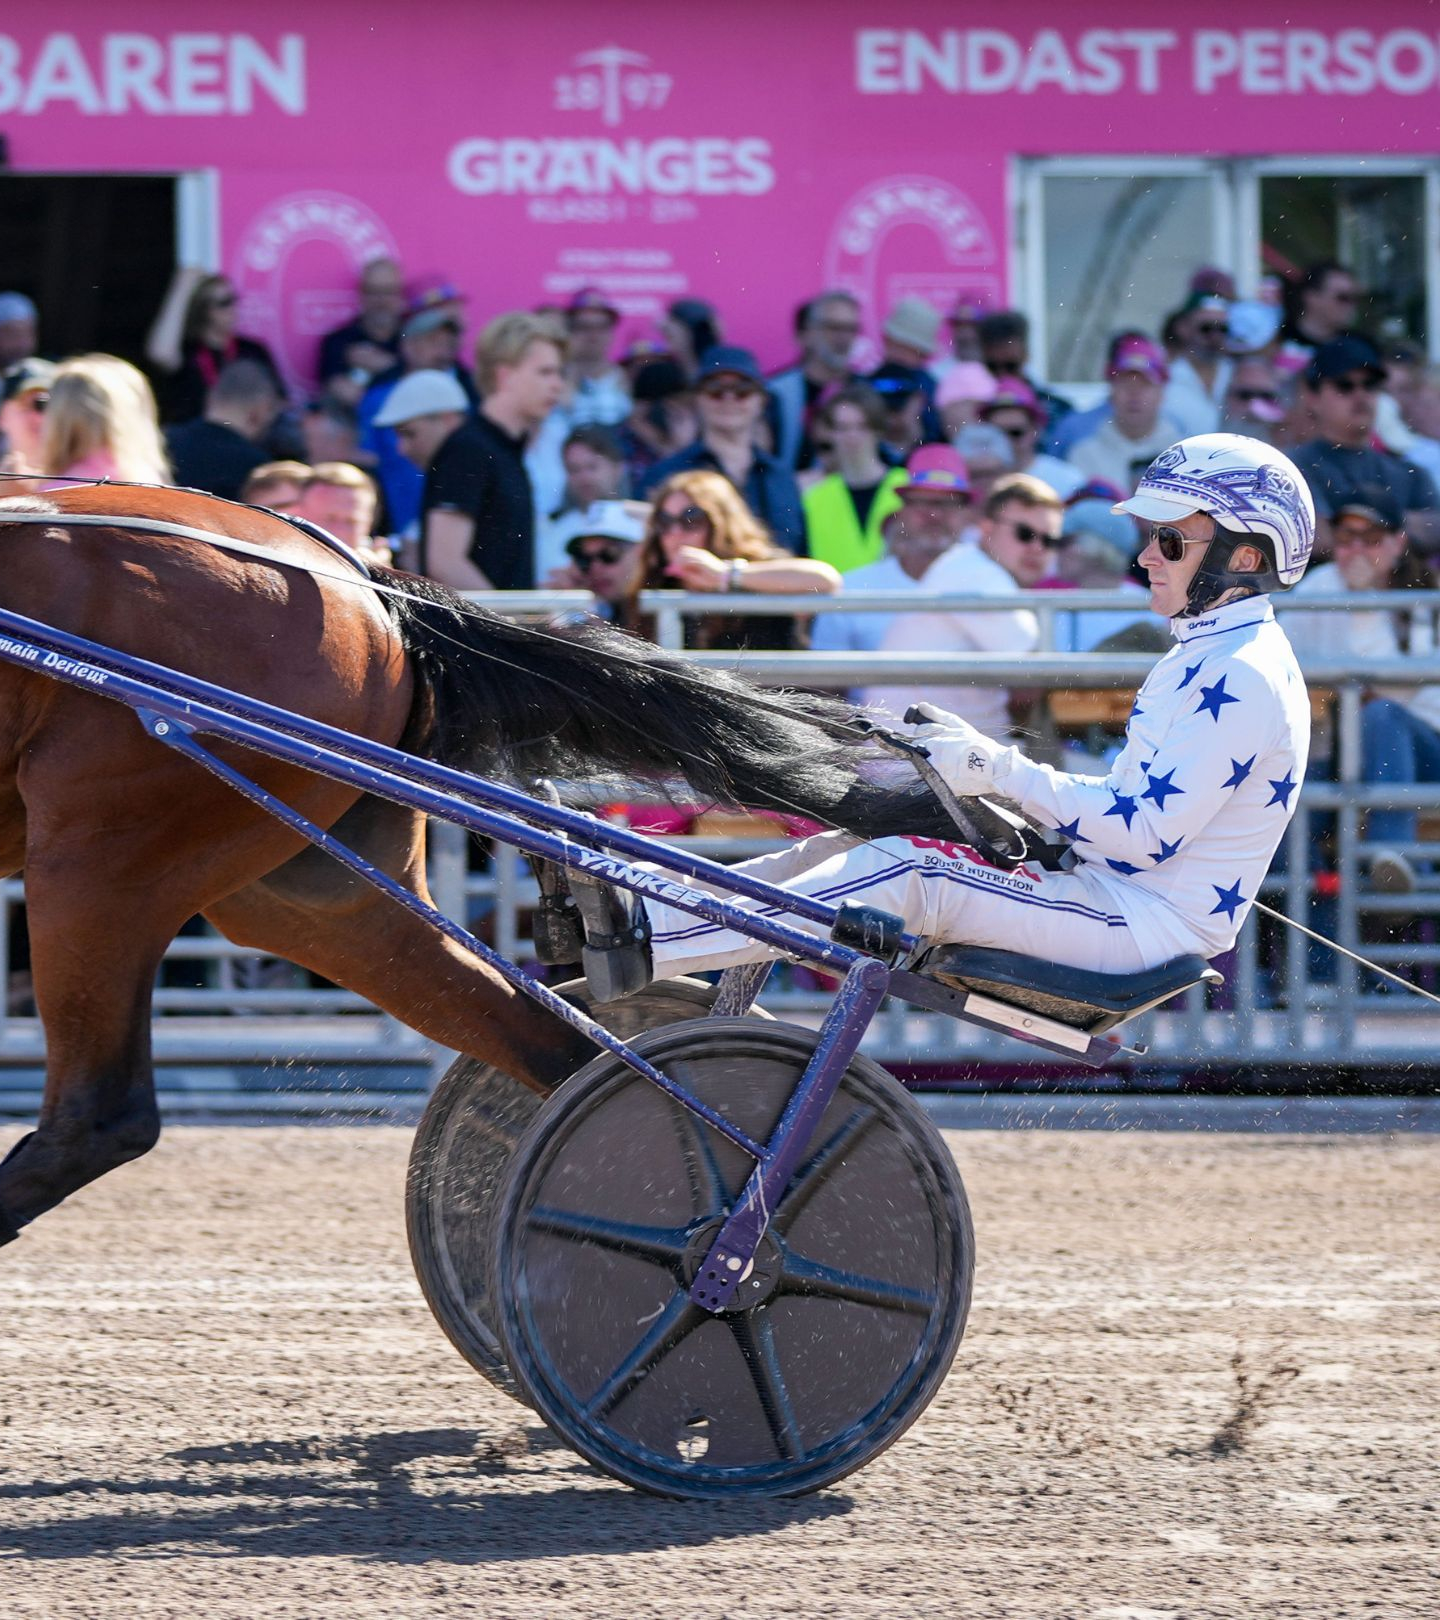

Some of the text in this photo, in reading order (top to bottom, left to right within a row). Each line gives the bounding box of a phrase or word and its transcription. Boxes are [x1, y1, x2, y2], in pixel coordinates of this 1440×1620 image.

[855, 28, 1440, 95] ENDAST PERSO
[623, 73, 673, 110] 97
[447, 136, 775, 196] GRÄNGES
[42, 652, 109, 685] Derieux
[578, 850, 705, 907] YANKEE
[967, 867, 1034, 892] NUTRITION
